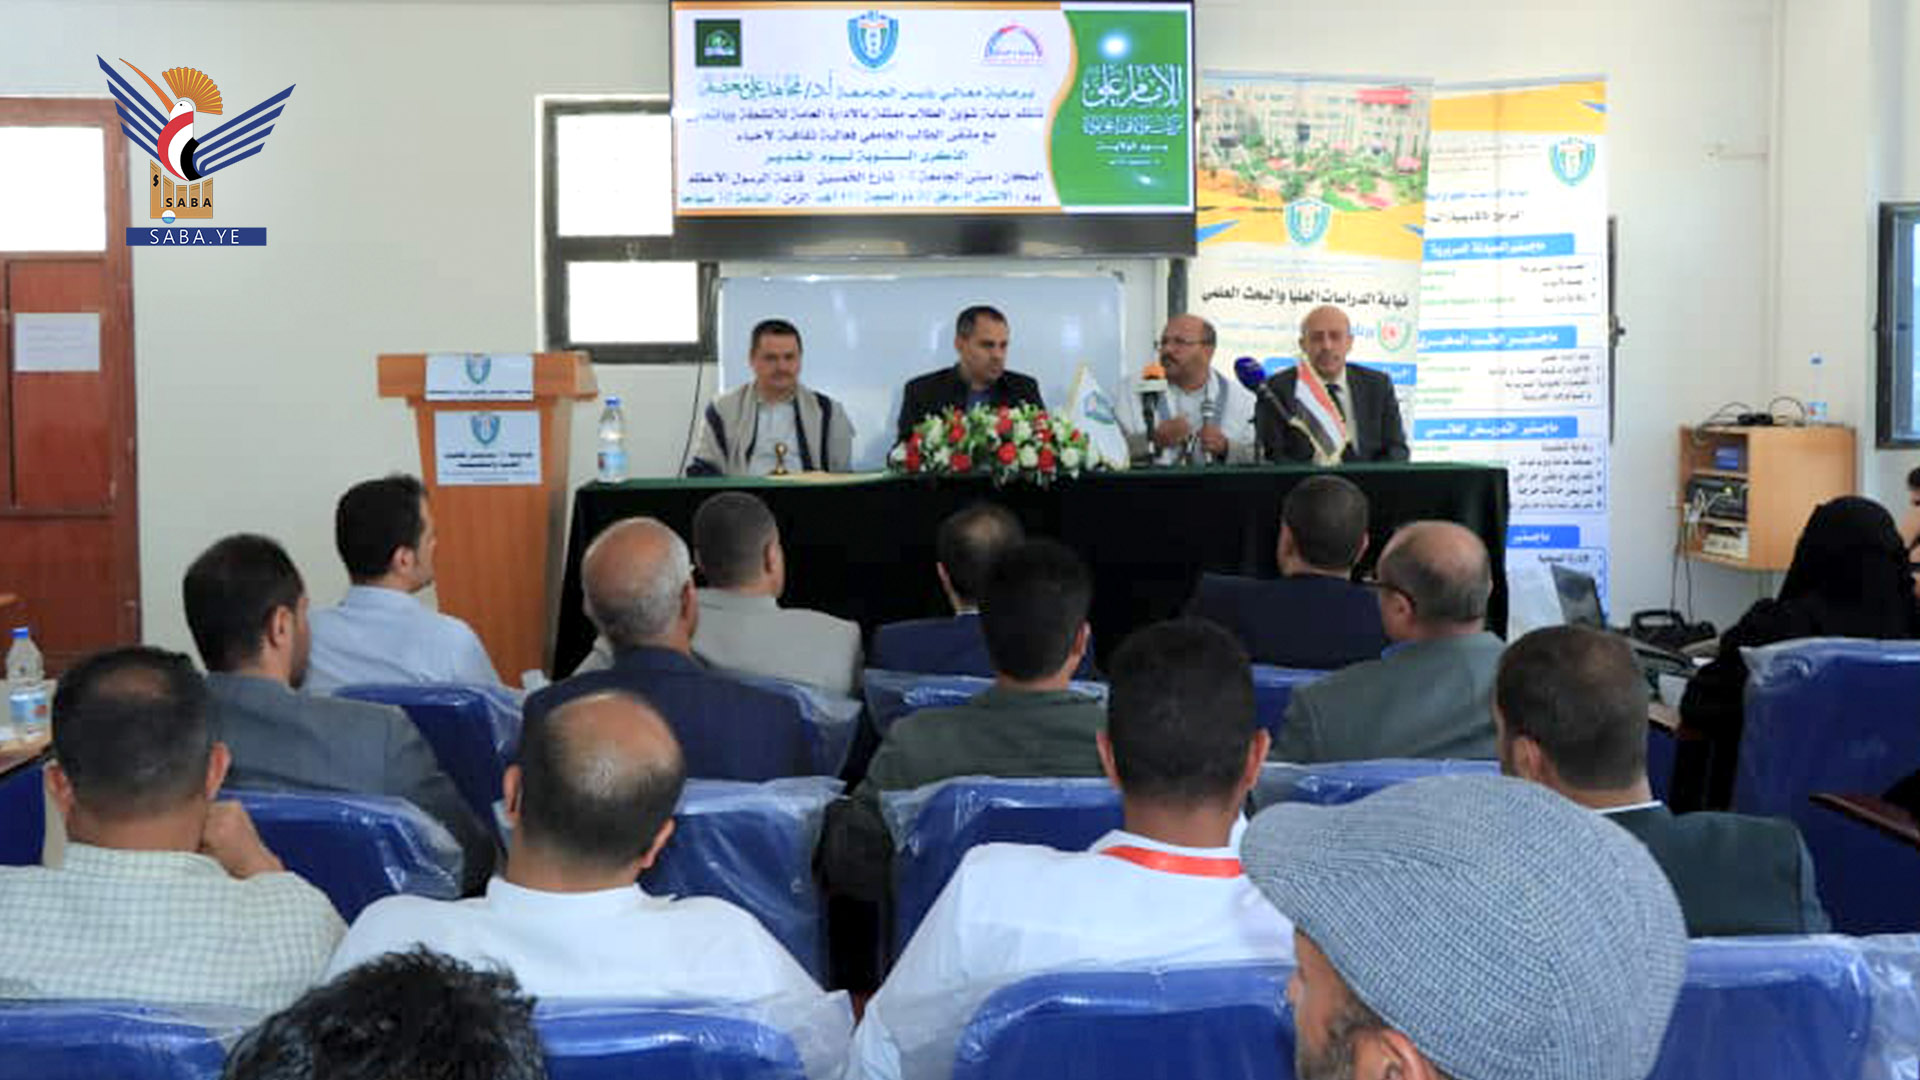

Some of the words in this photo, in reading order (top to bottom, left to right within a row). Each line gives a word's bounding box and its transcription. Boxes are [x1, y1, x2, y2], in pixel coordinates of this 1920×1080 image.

[1241, 285, 1285, 305] والبحث
[1289, 288, 1320, 303] العليا
[1321, 292, 1376, 308] الدراسات
